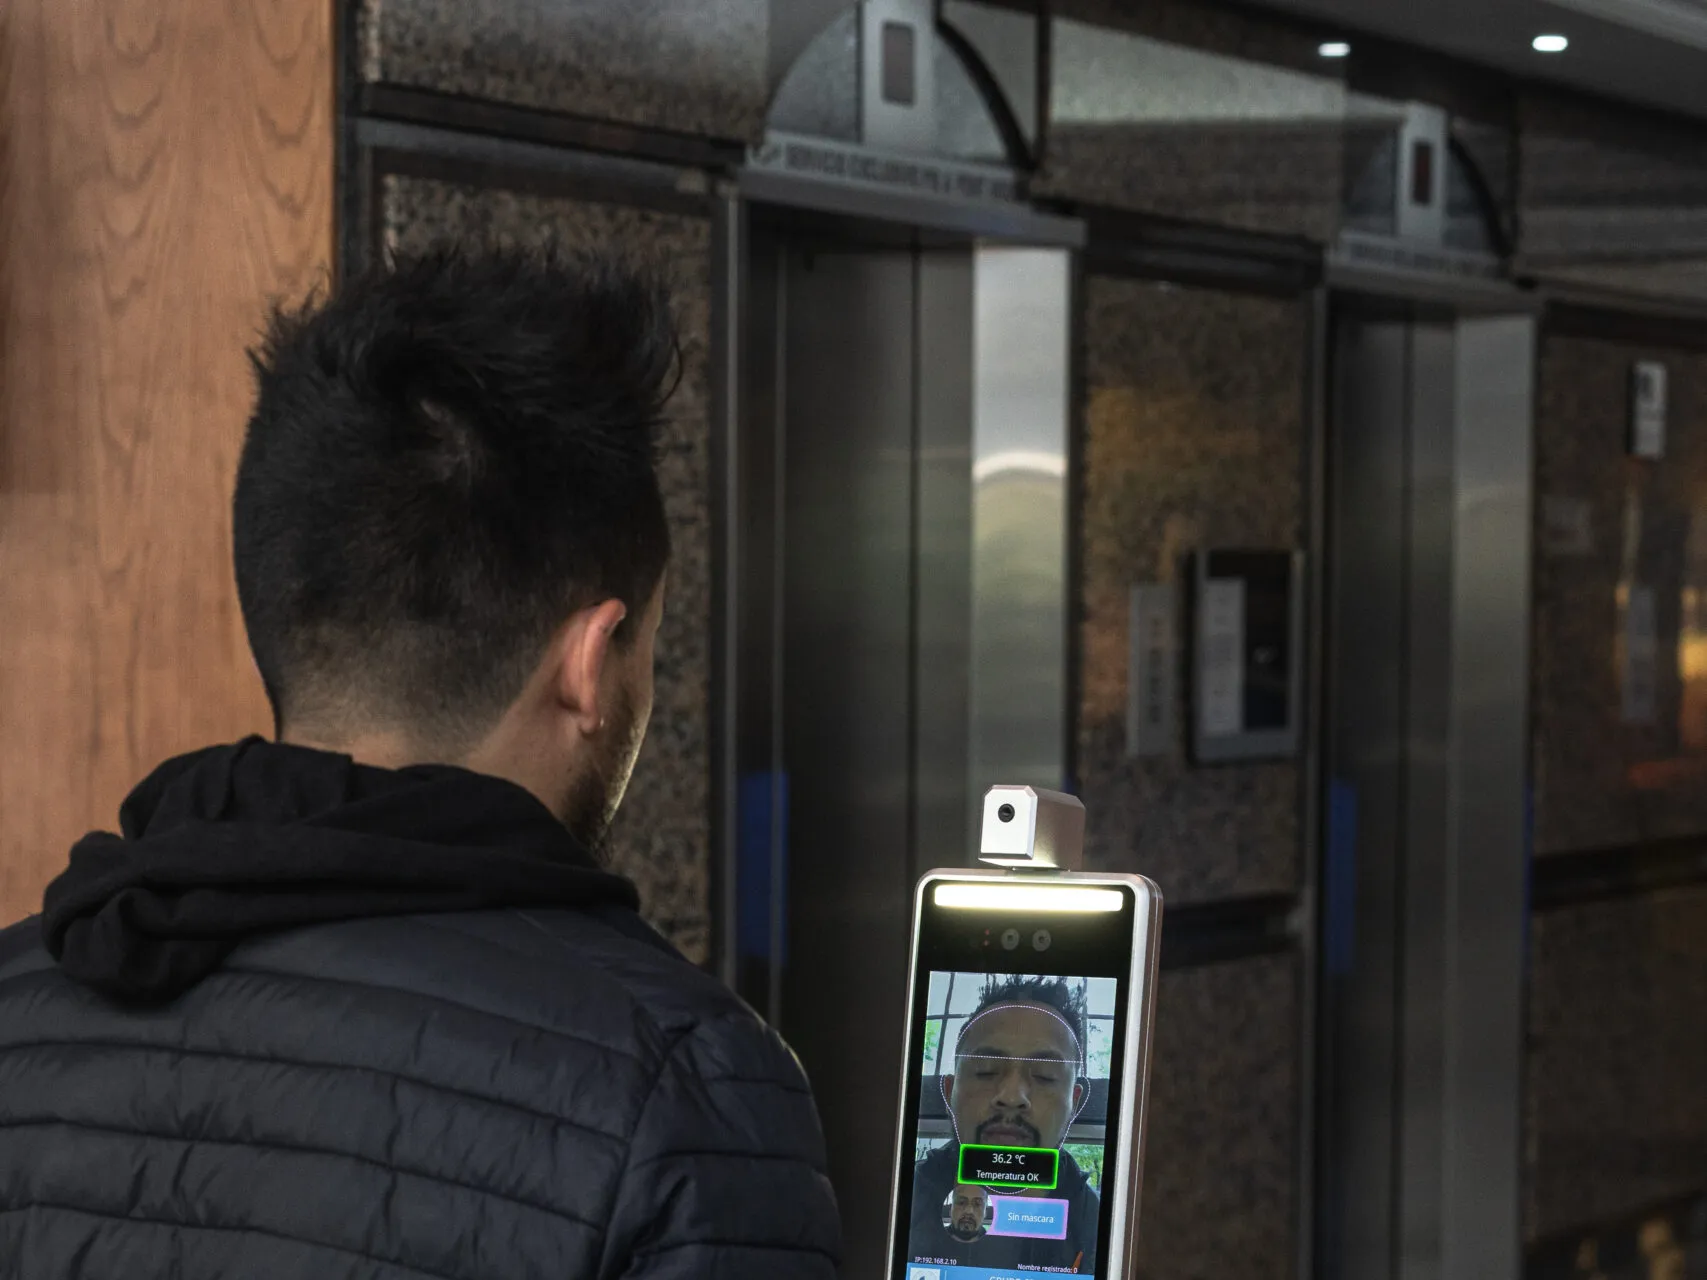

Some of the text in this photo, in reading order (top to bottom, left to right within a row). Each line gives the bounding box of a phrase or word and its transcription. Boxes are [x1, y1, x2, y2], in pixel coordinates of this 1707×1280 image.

[992, 1153, 1013, 1164] 36.2
[976, 1169, 1039, 1182] Temperatura OK
[1007, 1212, 1054, 1224] Sin mascara
[1017, 1263, 1040, 1272] Nombre
[1041, 1265, 1072, 1274] registrado:
